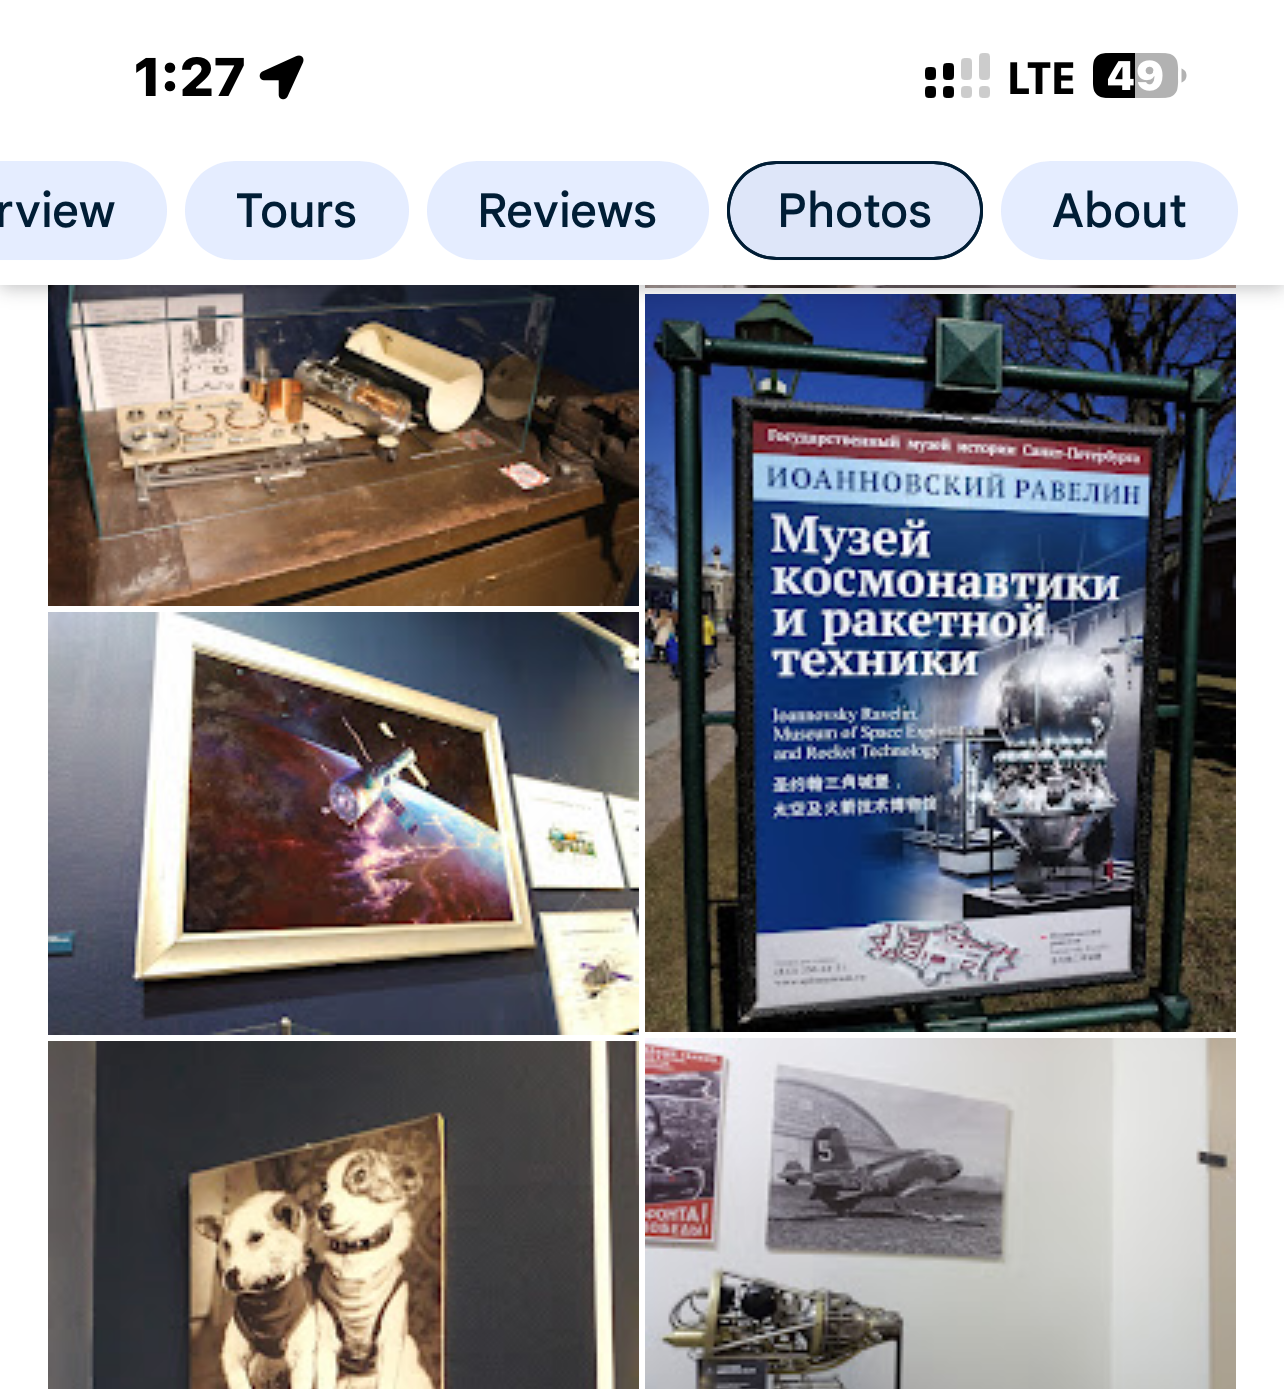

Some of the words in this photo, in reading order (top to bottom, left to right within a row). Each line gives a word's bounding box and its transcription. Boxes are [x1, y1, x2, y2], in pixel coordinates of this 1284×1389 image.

[136, 57, 244, 96] 1:27
[1010, 62, 1073, 94] LTE
[1108, 60, 1163, 91] 49
[0, 190, 115, 228] rview
[237, 193, 355, 228] Tours
[481, 190, 655, 228] Reviews
[781, 190, 930, 228] Photos
[1053, 190, 1185, 228] About
[767, 428, 900, 450] Государственный
[907, 437, 951, 454] музей
[957, 442, 1016, 457] истории
[1022, 443, 1141, 465] Санкт-Петербурга
[767, 465, 1006, 499] ИОАННОВСКИЙ
[1015, 478, 1141, 505] РАВЕЛИН
[770, 512, 931, 565] Музей
[771, 565, 1120, 601] космонавтики
[772, 608, 807, 637] и
[821, 602, 1047, 646] ракетной
[772, 648, 980, 679] техники
[773, 726, 837, 742] Museum
[840, 725, 857, 740] of
[860, 725, 902, 742] Space
[773, 745, 802, 761] and
[806, 744, 857, 761] Rocket
[861, 742, 940, 761] Technology
[818, 1140, 832, 1162] 5
